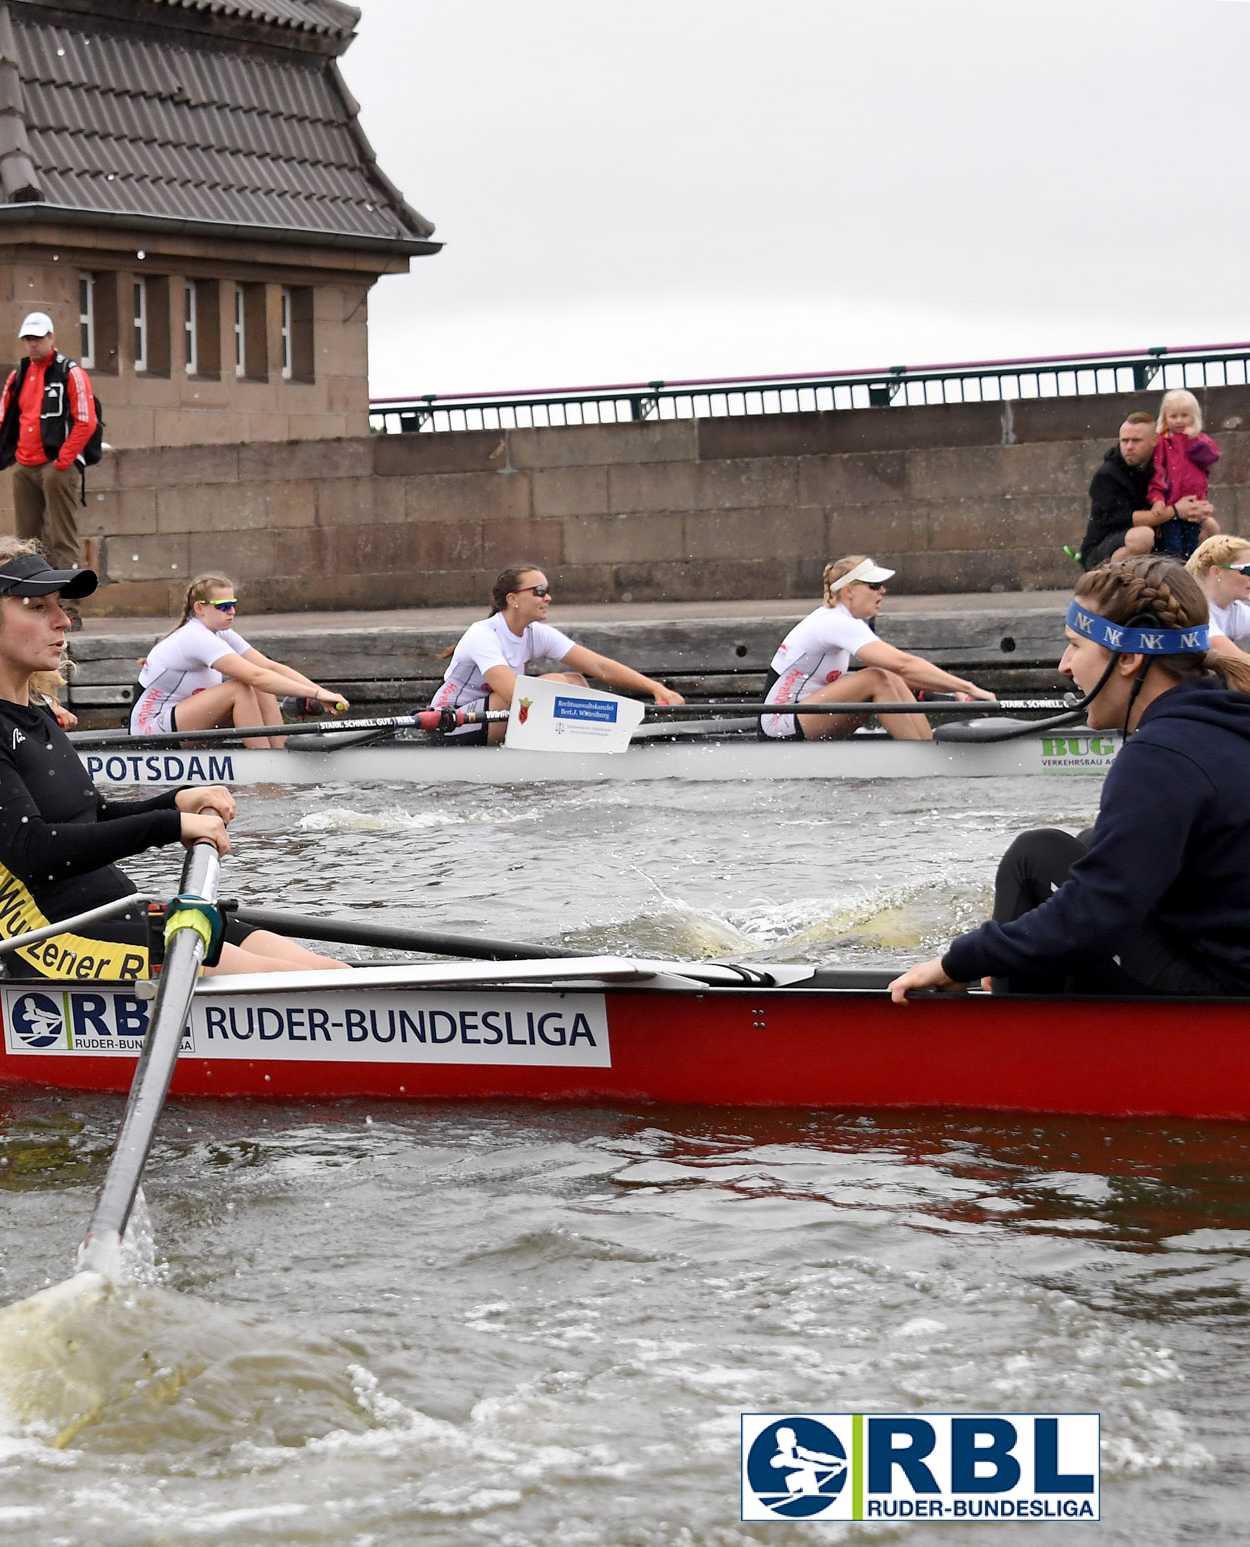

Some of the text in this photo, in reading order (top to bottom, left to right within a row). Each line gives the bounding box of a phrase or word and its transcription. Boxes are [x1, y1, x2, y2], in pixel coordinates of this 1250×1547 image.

[1073, 612, 1201, 650] NK NK NK NK
[1000, 700, 1028, 709] STARK.
[1027, 700, 1063, 709] SCHNELL.
[319, 721, 344, 730] STARK.
[344, 719, 377, 728] SCHNELL.
[376, 717, 393, 726] GUT.
[1039, 737, 1114, 756] BUG
[86, 756, 235, 782] POTSDAM
[119, 953, 145, 979] R
[70, 994, 191, 1038] RB
[204, 1006, 598, 1047] RUDER-BUNDESLIGA
